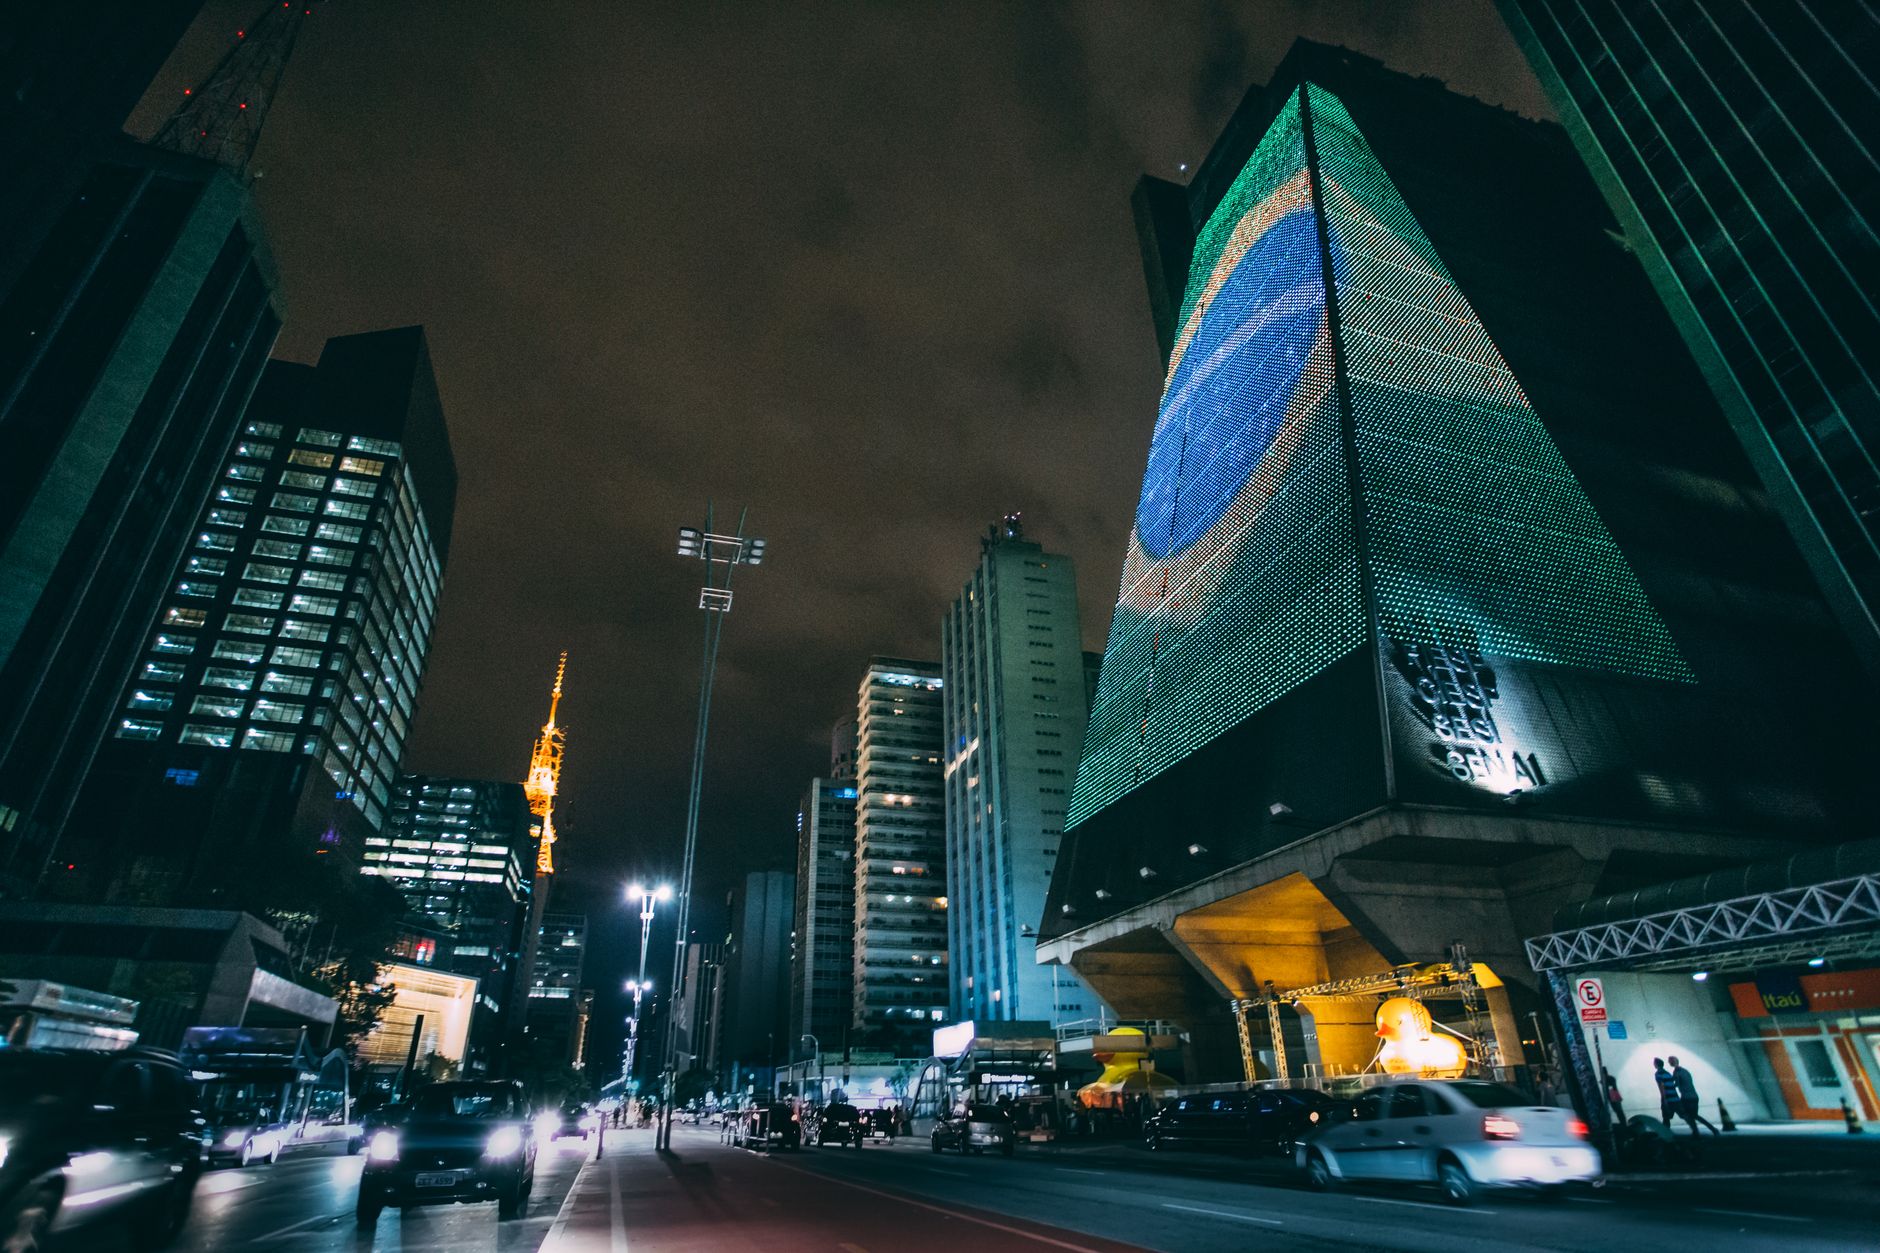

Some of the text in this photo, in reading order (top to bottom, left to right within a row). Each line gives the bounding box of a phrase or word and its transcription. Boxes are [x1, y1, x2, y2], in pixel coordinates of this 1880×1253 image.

[1432, 714, 1500, 744] SESI
[1446, 749, 1547, 785] SENAI
[1762, 991, 1803, 1009] Itaú
